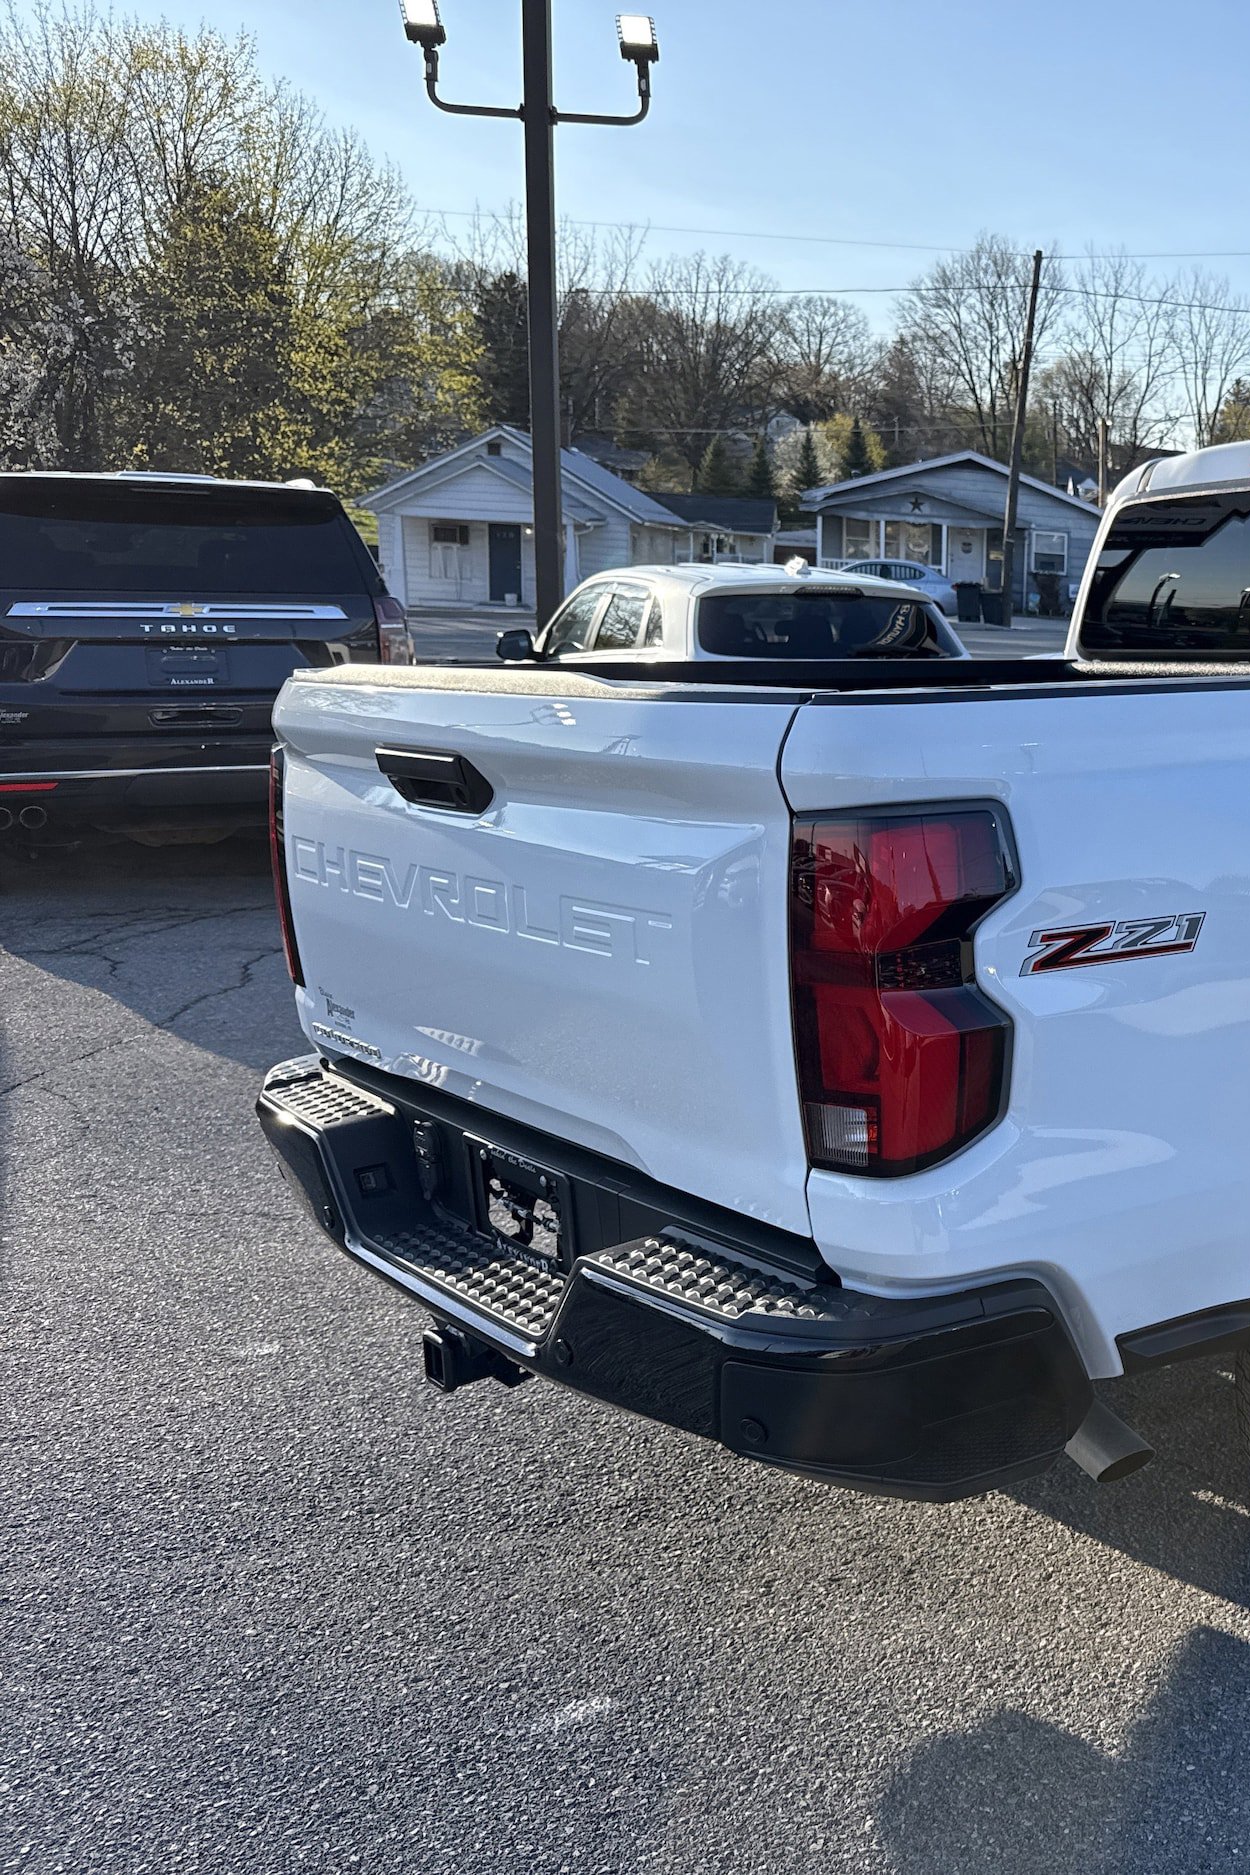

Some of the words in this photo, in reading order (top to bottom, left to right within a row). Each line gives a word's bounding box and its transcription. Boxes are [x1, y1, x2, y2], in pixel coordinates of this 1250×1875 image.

[139, 624, 236, 633] TAHOE
[290, 833, 674, 967] CHEVROLET
[1018, 911, 1207, 978] Z71
